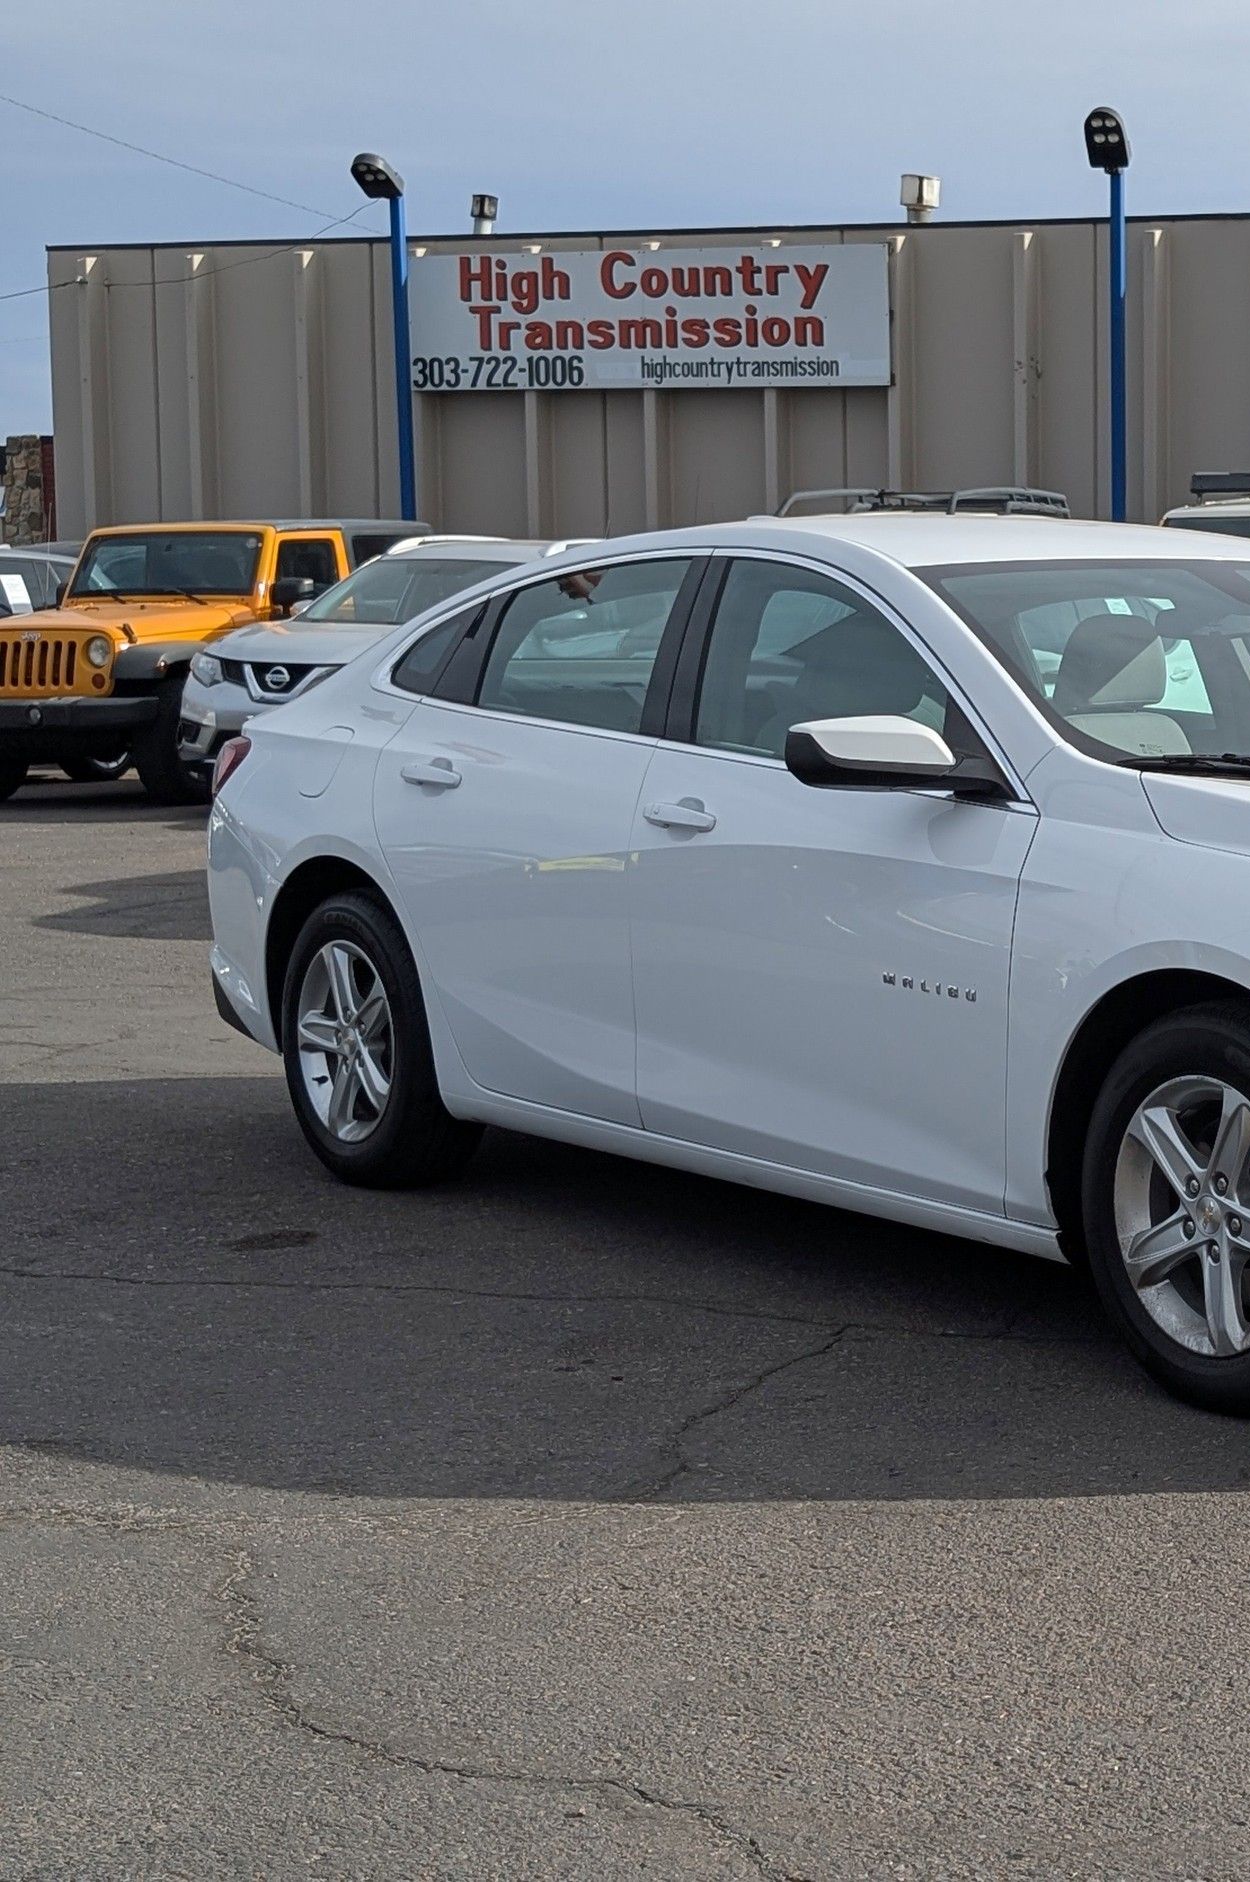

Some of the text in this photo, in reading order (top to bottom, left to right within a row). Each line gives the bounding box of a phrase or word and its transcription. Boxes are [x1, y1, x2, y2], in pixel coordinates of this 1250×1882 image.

[459, 251, 830, 315] High Country
[468, 304, 825, 351] Transmission
[412, 355, 840, 389] 303-722-1006 highcountrytransmission
[882, 971, 977, 1003] MALIBU
